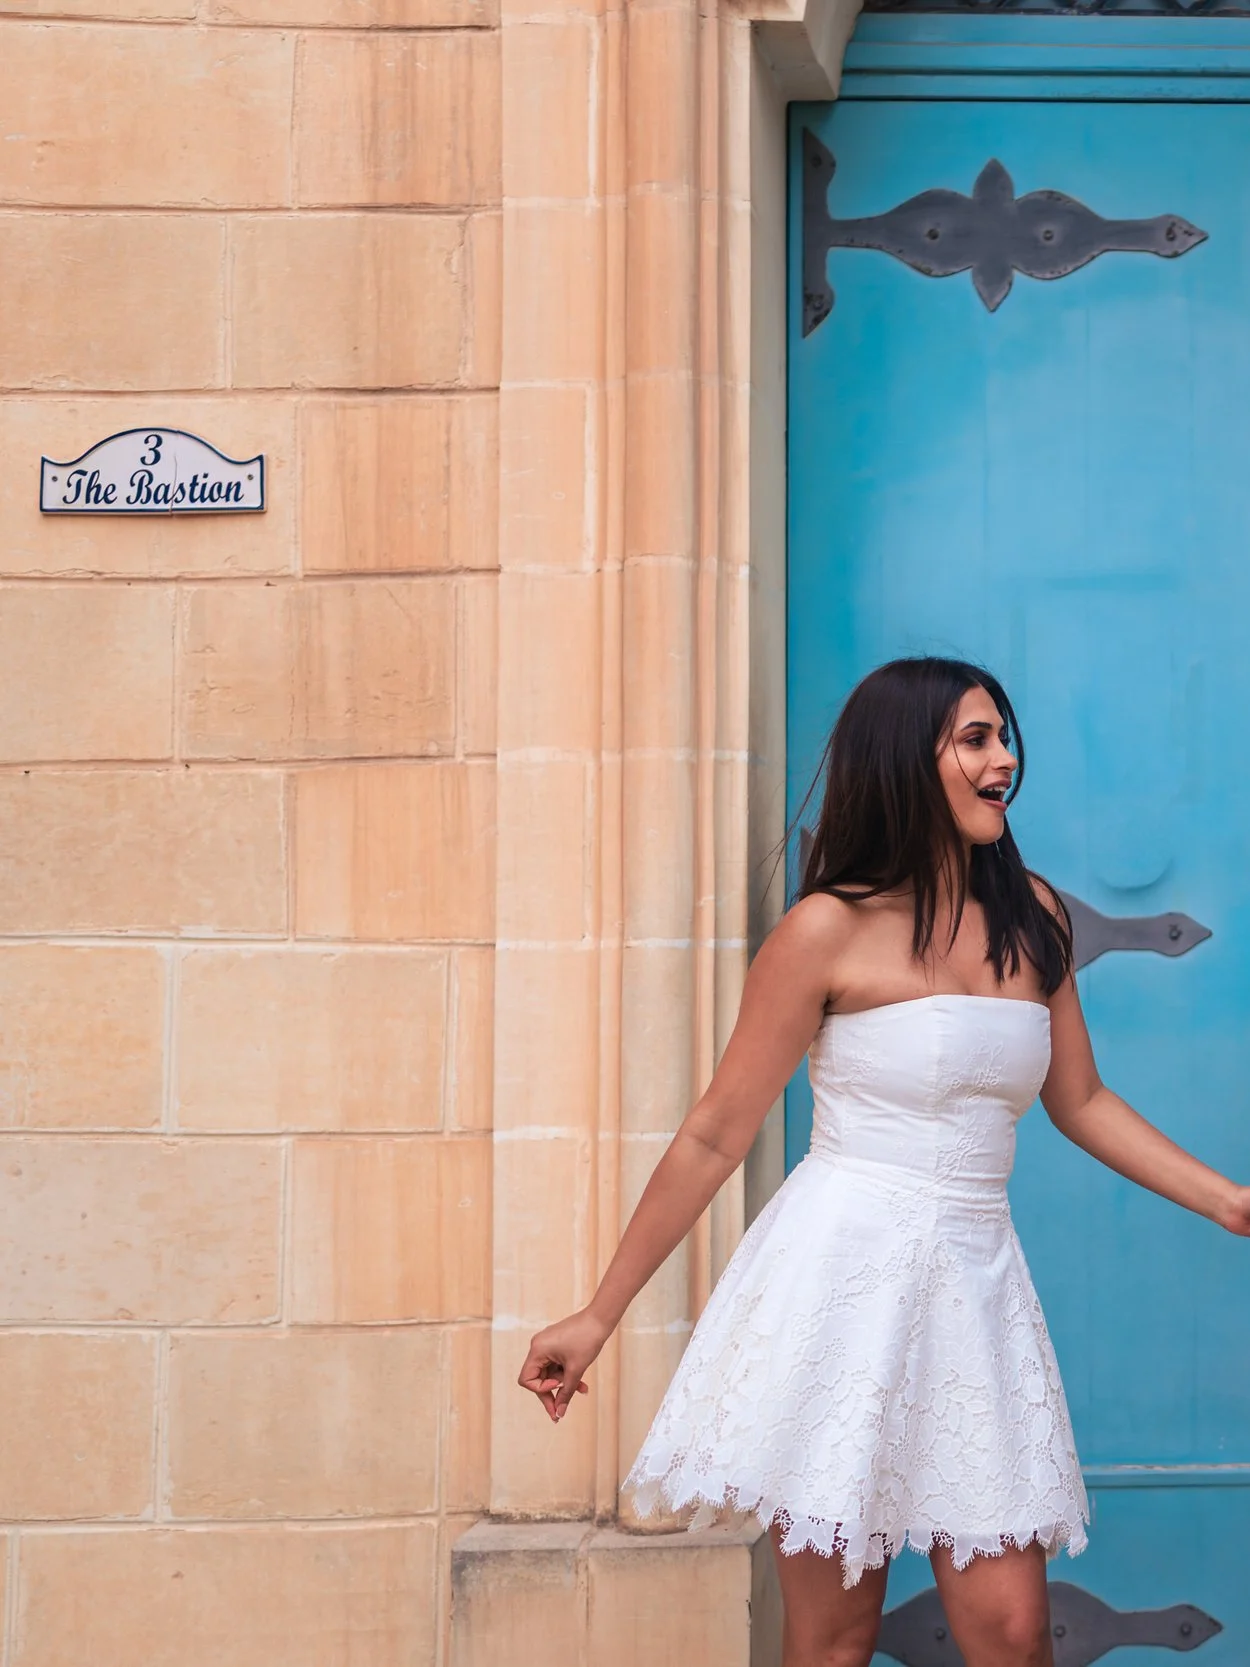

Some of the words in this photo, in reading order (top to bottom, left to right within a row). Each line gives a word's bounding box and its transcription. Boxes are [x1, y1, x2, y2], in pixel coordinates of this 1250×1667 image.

[140, 434, 163, 466] 3
[62, 469, 118, 505] The
[125, 469, 244, 505] Bastion
